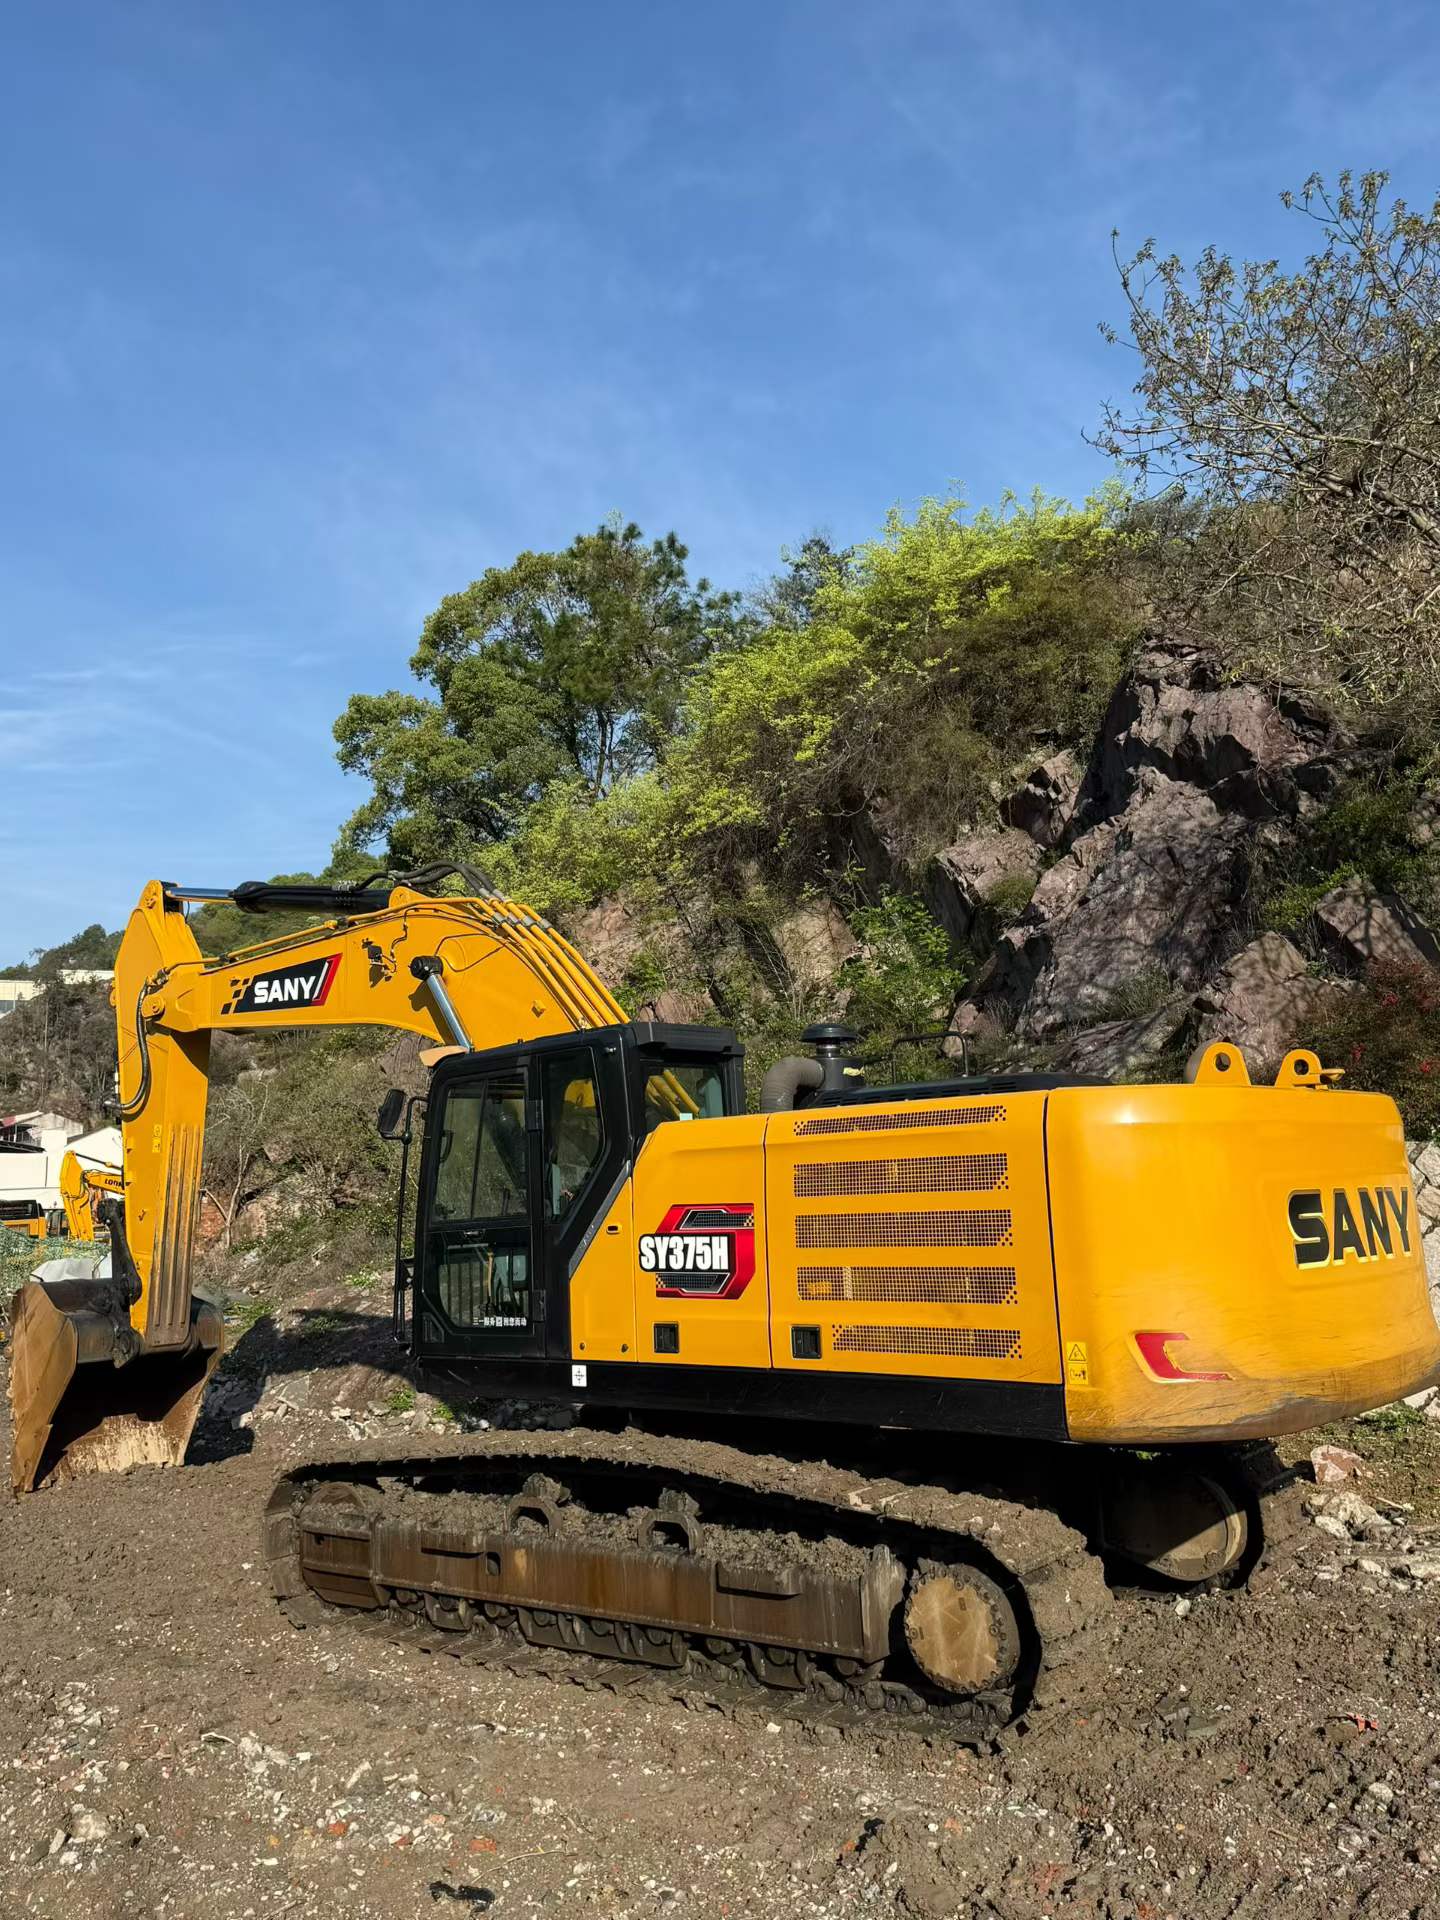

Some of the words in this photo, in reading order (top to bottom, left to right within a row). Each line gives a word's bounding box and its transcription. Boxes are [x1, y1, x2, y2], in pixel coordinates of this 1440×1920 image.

[254, 975, 316, 1004] SANY
[1288, 1188, 1411, 1270] SANY
[640, 1235, 729, 1270] SY375H
